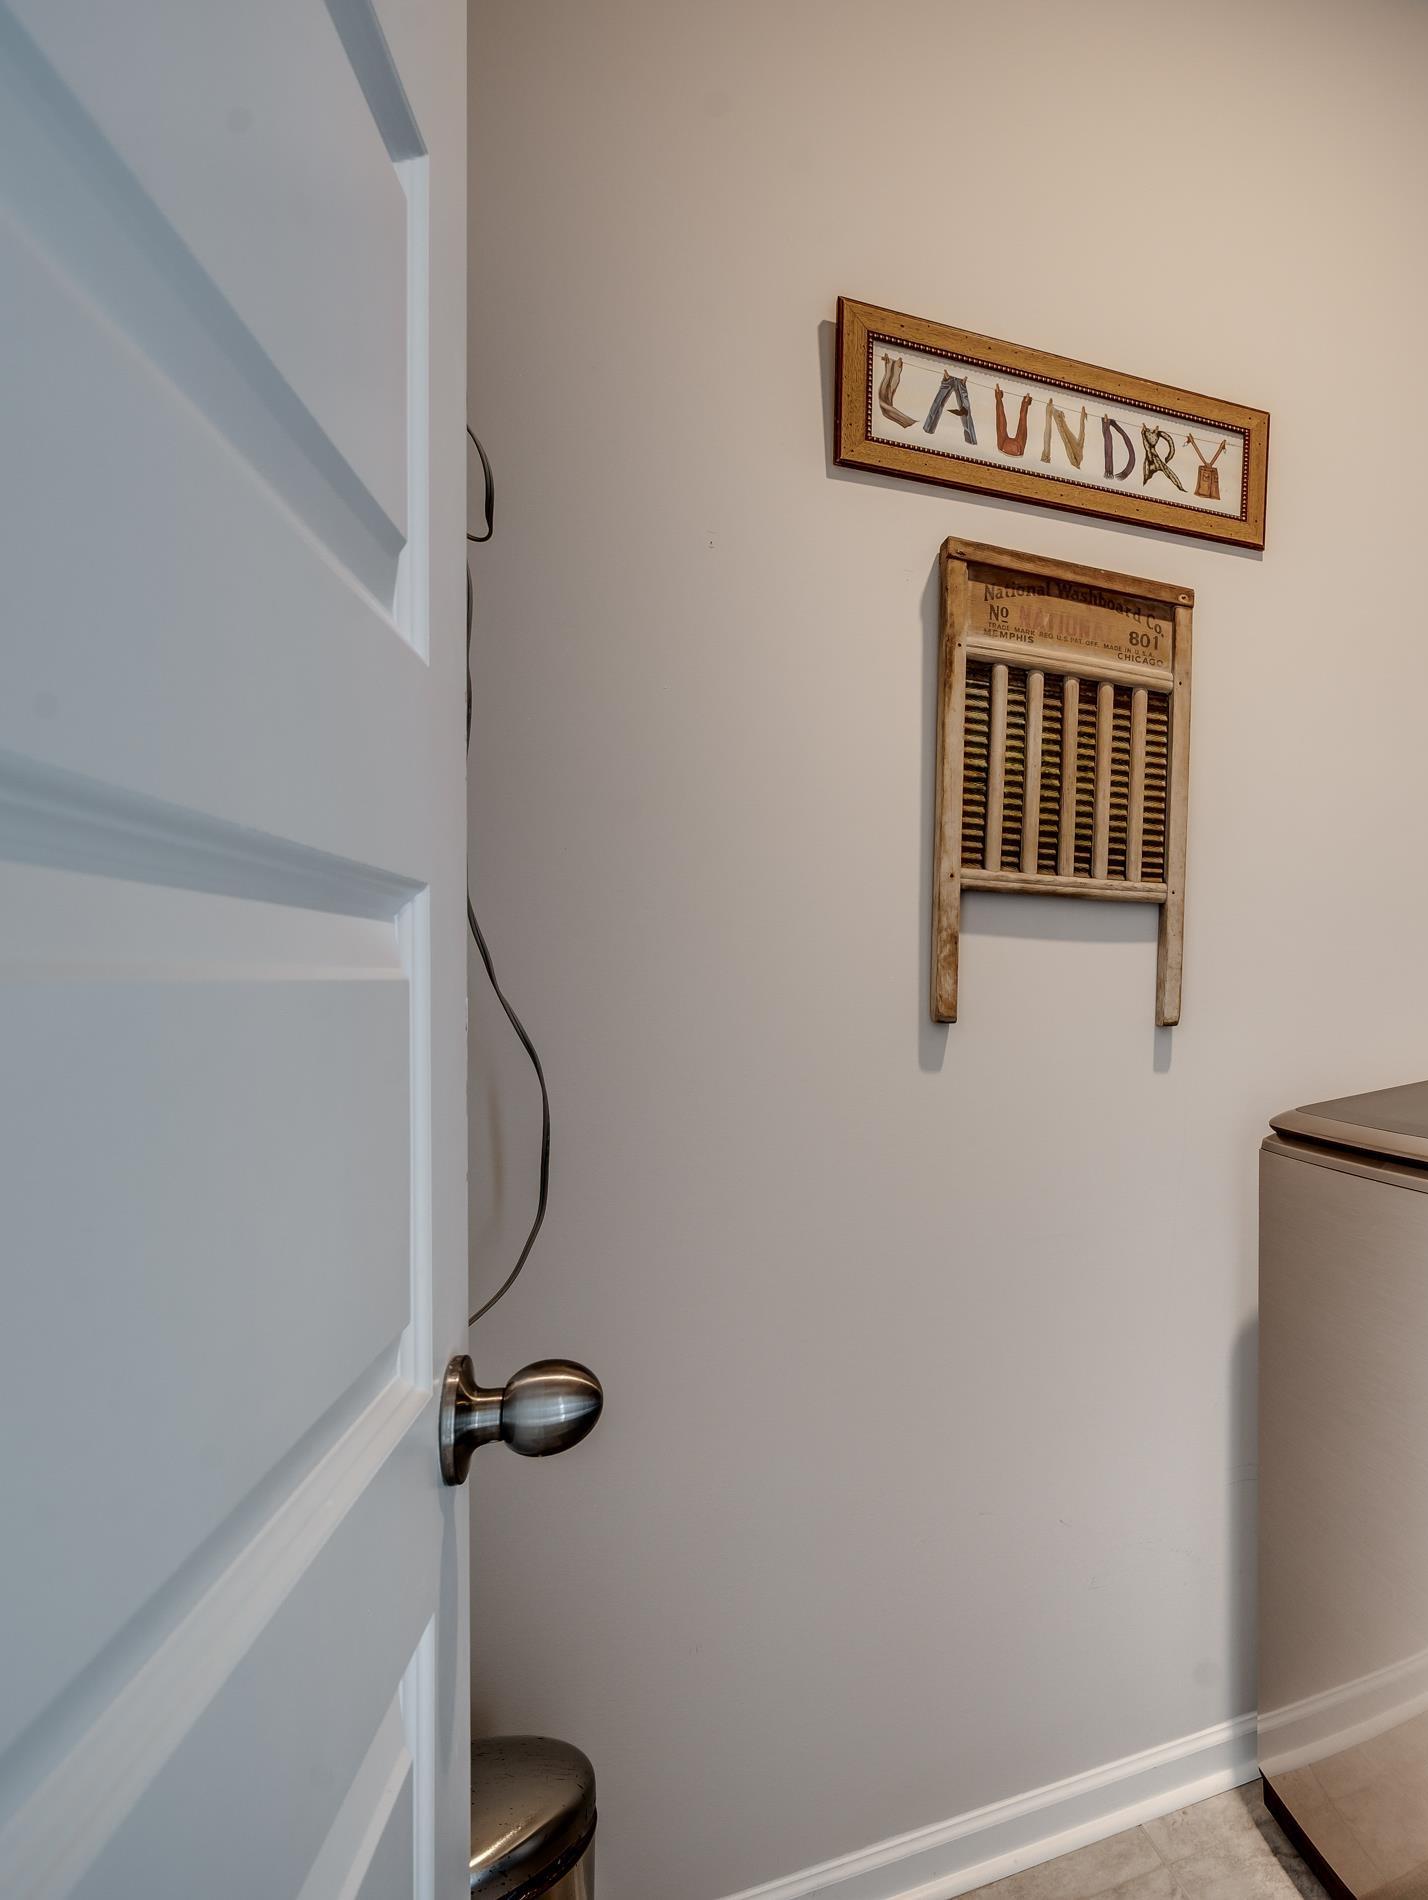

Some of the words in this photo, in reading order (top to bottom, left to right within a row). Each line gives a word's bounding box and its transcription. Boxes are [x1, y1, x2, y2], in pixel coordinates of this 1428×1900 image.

[878, 354, 1227, 500] LAUNDRY
[984, 581, 1050, 601] National
[1146, 614, 1164, 638] Co.
[984, 628, 1034, 644] MEMPHIS
[1014, 627, 1036, 636] MARK
[1103, 643, 1122, 652] MADE
[1129, 631, 1159, 650] 801
[1117, 652, 1164, 666] CHICAGO
